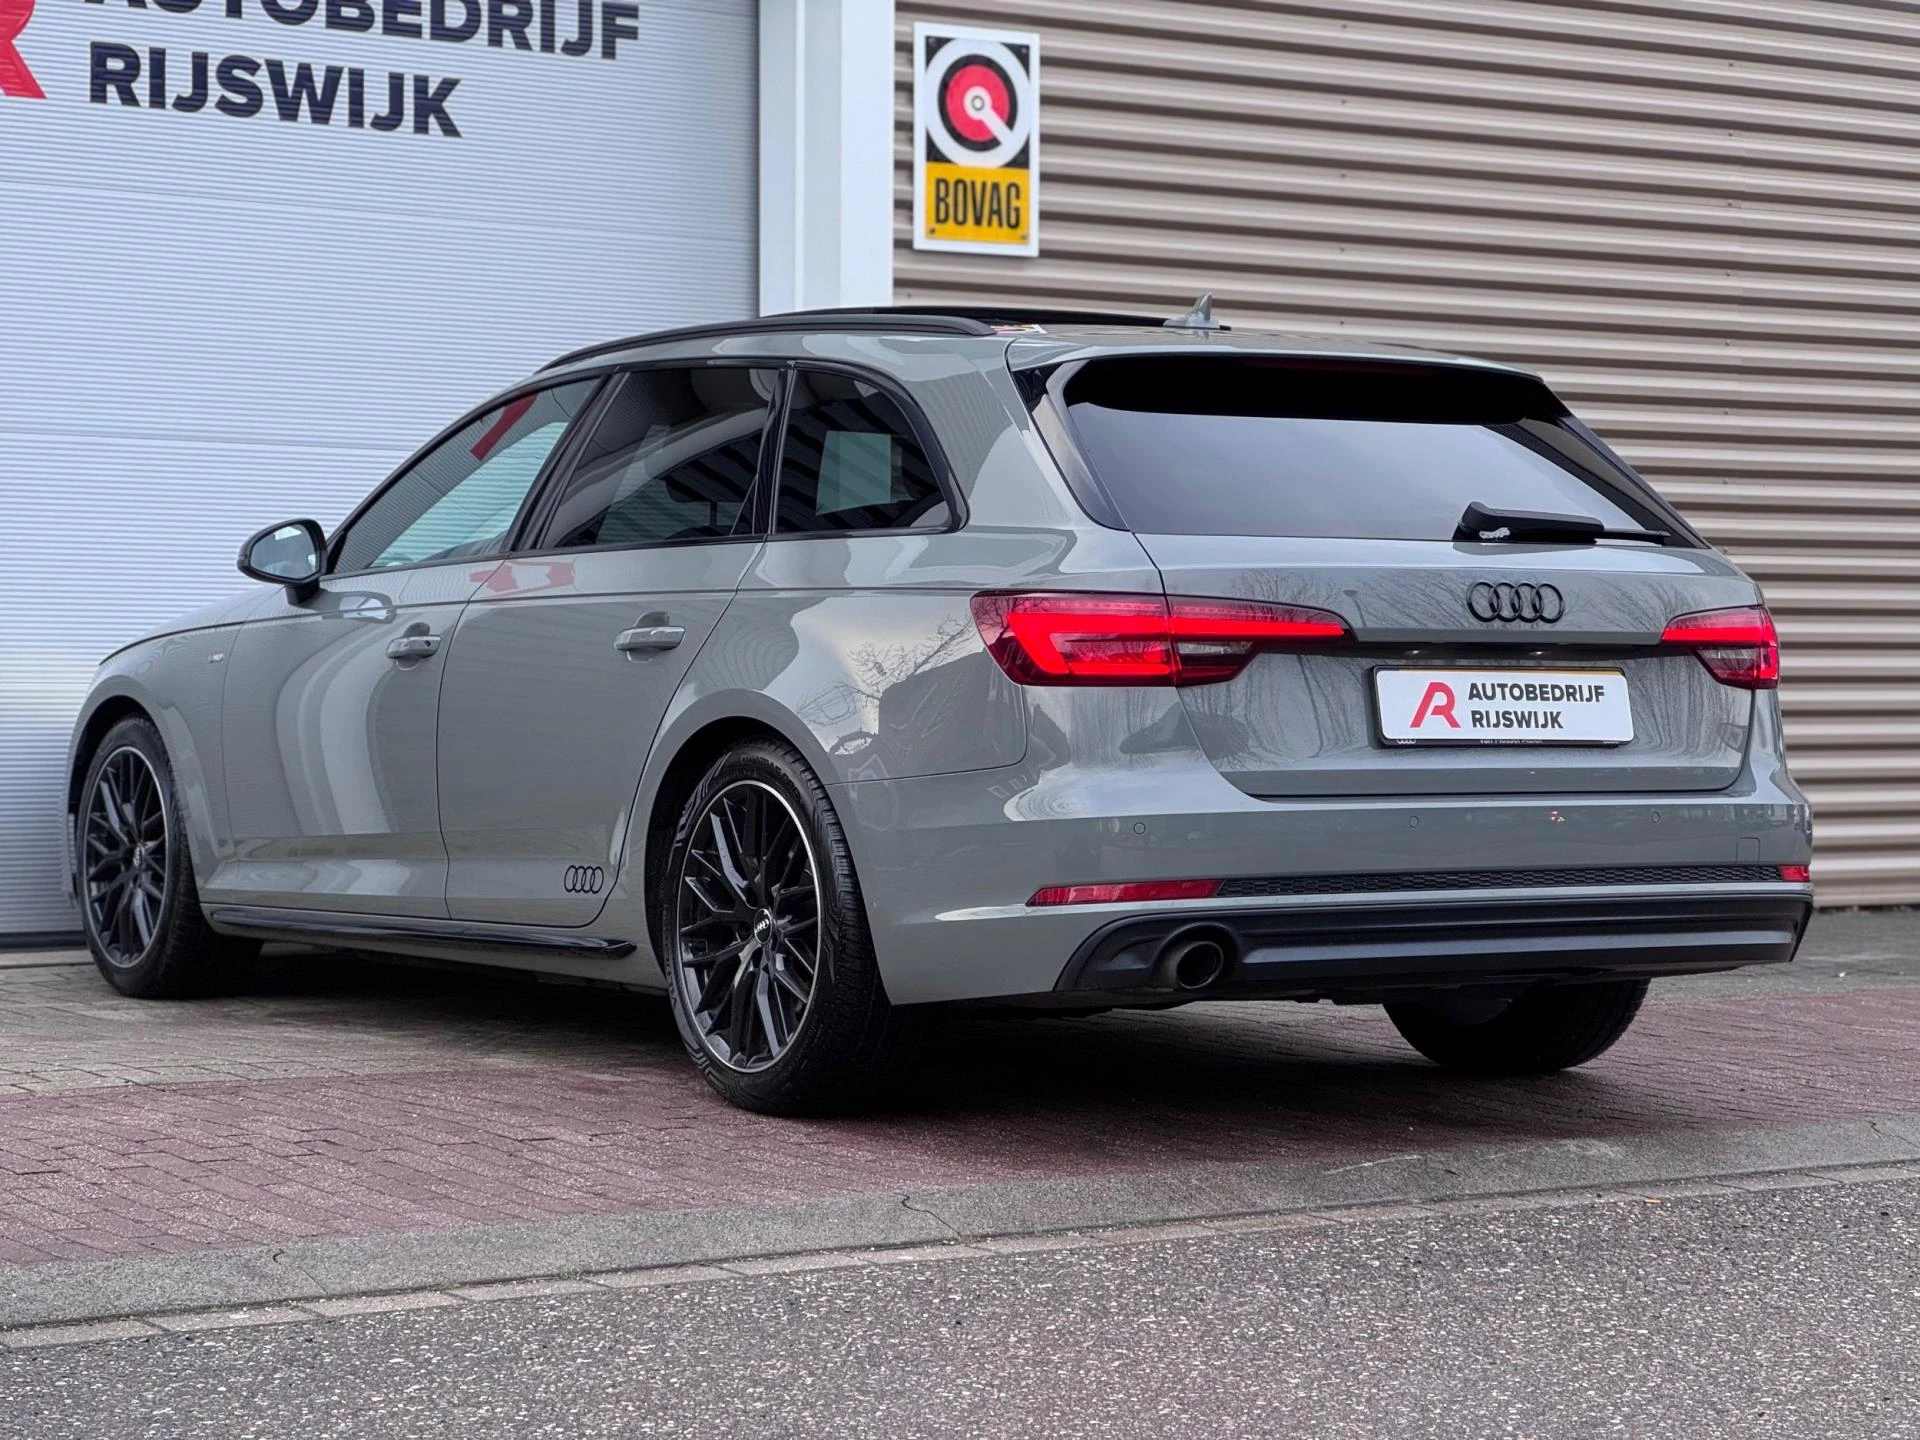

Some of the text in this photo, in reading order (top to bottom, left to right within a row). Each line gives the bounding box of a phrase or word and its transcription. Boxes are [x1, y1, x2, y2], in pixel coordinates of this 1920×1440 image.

[85, 0, 639, 60] BEDRIJF
[90, 41, 463, 138] RIJSWIJK
[935, 178, 1021, 230] BOVAG
[1468, 682, 1605, 703] AUTOBEDRIJF
[1471, 710, 1564, 729] RIJSWIJK
